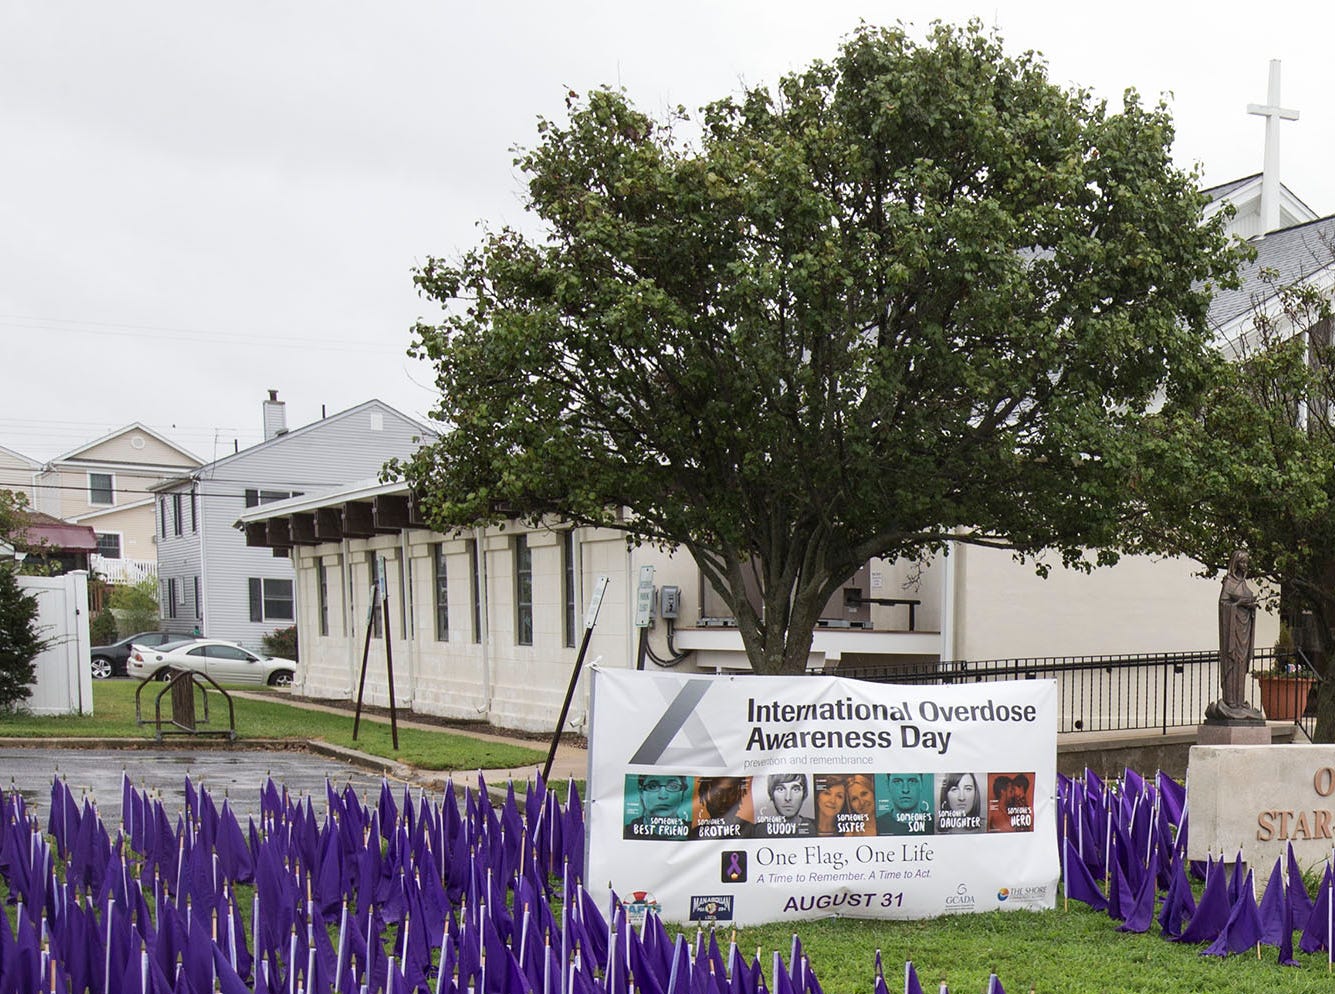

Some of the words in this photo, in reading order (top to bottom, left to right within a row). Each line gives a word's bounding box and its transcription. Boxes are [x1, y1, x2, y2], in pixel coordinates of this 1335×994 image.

[747, 697, 912, 722] International
[919, 699, 1036, 722] Overdose
[746, 726, 892, 751] Awareness
[900, 725, 951, 754] Day
[744, 756, 786, 769] prevention
[790, 755, 807, 765] and
[809, 755, 873, 765] remembrance
[896, 812, 932, 822] SOMEONE'S
[938, 810, 966, 818] SOMEONE'S
[1007, 807, 1032, 815] SOMEONE'S
[650, 817, 684, 825] SOMEONE'S
[697, 818, 726, 826] SOMEONE'S
[757, 816, 786, 824] SOMEONE'S
[837, 813, 869, 822] SOMEONE'S
[940, 816, 981, 828] DAUGHTER
[1010, 814, 1031, 826] HERO
[633, 824, 655, 835] BEST
[658, 825, 689, 836] FRIEND
[698, 824, 741, 837] BROTHER
[766, 823, 797, 835] BUDDY
[908, 821, 925, 832] SON
[1256, 808, 1333, 841] STAR
[756, 846, 797, 866] One
[804, 845, 849, 870] Flag,
[856, 844, 895, 863] One
[901, 842, 935, 862] Life
[756, 874, 765, 884] A
[768, 873, 793, 883] Time
[796, 873, 805, 882] to
[809, 871, 866, 882] Remember.
[868, 871, 876, 880] A
[879, 870, 901, 880] Time
[904, 869, 913, 879] to
[915, 868, 932, 878] Act.
[783, 892, 877, 912] AUGUST
[881, 892, 904, 908] 31
